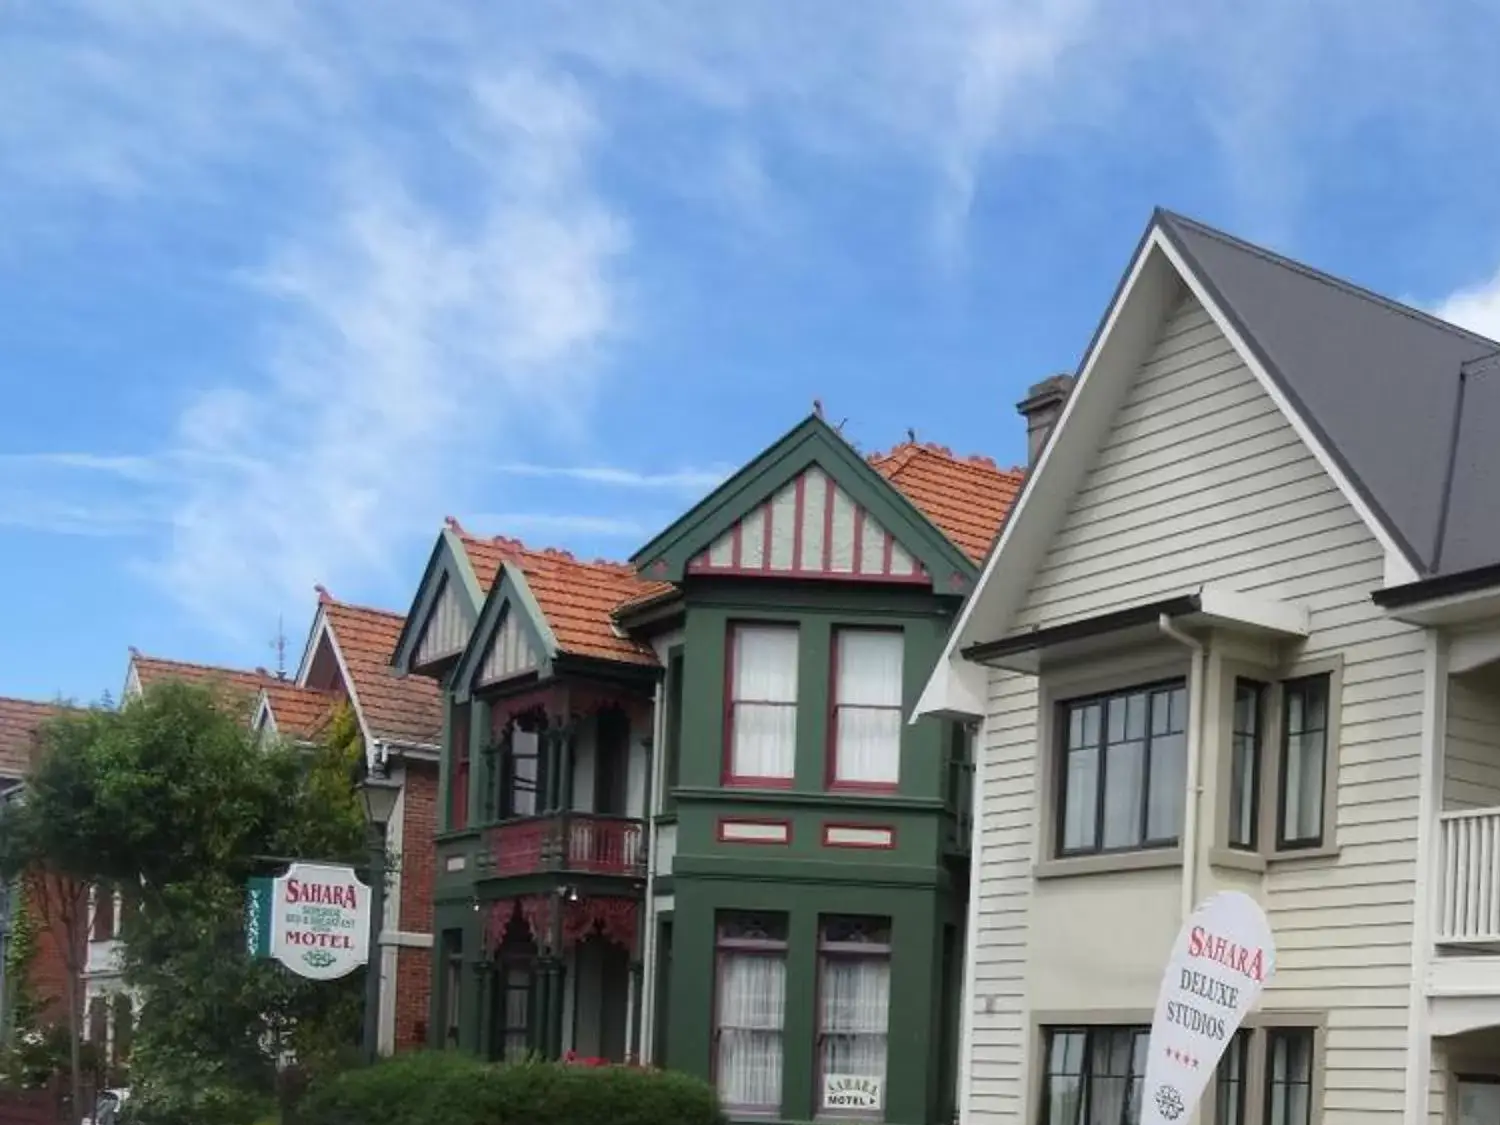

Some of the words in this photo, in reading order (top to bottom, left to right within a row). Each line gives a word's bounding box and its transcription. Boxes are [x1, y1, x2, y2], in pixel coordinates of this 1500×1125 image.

[286, 880, 356, 909] SAHARA
[286, 931, 355, 950] MOTEL
[1187, 926, 1265, 983] SAHARA
[1180, 968, 1239, 1010] DELUXE
[1167, 1000, 1226, 1041] STUDIOS
[828, 1095, 866, 1106] MOTEL
